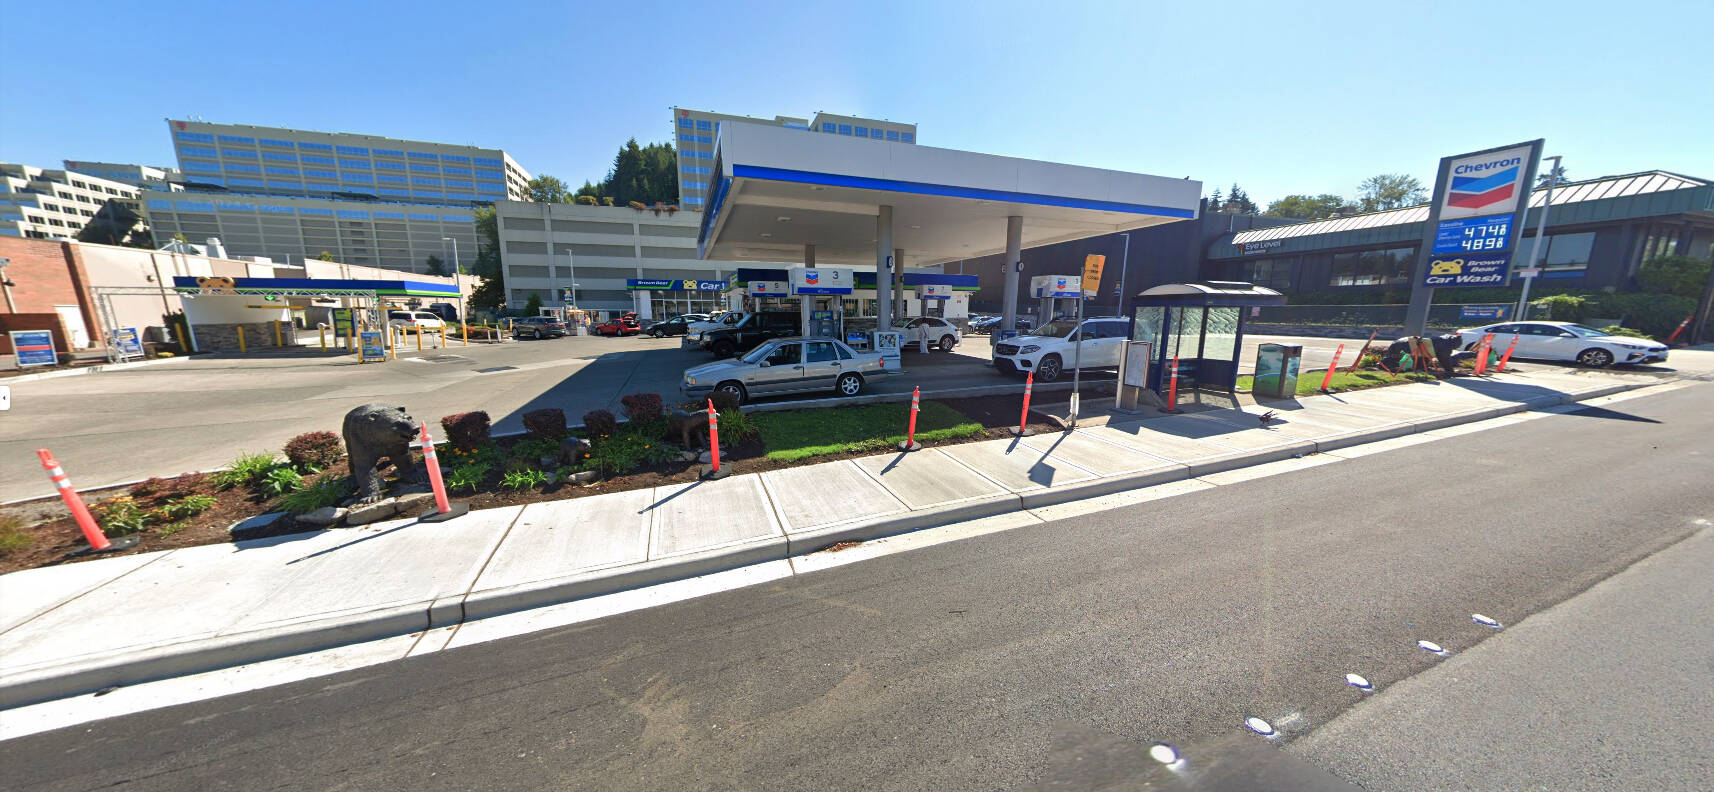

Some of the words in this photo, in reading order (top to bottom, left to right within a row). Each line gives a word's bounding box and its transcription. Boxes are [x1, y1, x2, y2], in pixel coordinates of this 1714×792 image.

[1454, 157, 1521, 174] Chevron
[832, 271, 839, 280] 3
[1426, 276, 1454, 284] Car
[1456, 273, 1502, 283] Wash
